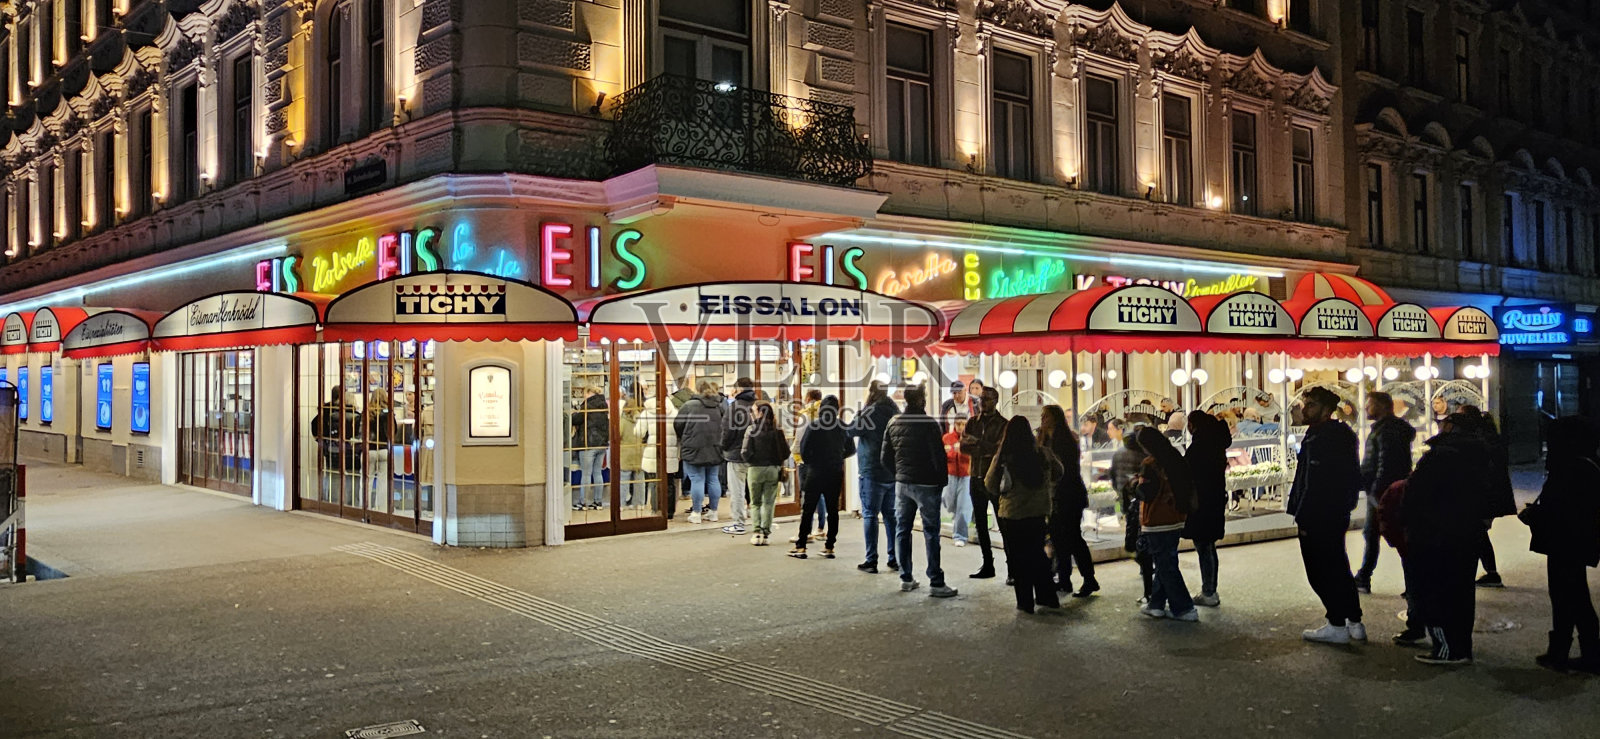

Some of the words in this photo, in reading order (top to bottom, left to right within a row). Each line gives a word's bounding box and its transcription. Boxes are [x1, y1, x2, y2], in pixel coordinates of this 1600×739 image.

[539, 222, 648, 290] EIS
[256, 255, 300, 293] EIS
[401, 296, 500, 314] TICHY
[700, 294, 861, 317] EISSALON
[1120, 307, 1175, 324] TICHY
[1230, 312, 1275, 327] TICHY
[1319, 316, 1357, 330] TICHY
[1394, 318, 1427, 332] TICHY
[1458, 321, 1487, 334] TICHY
[1499, 332, 1568, 345] JUWELIER
